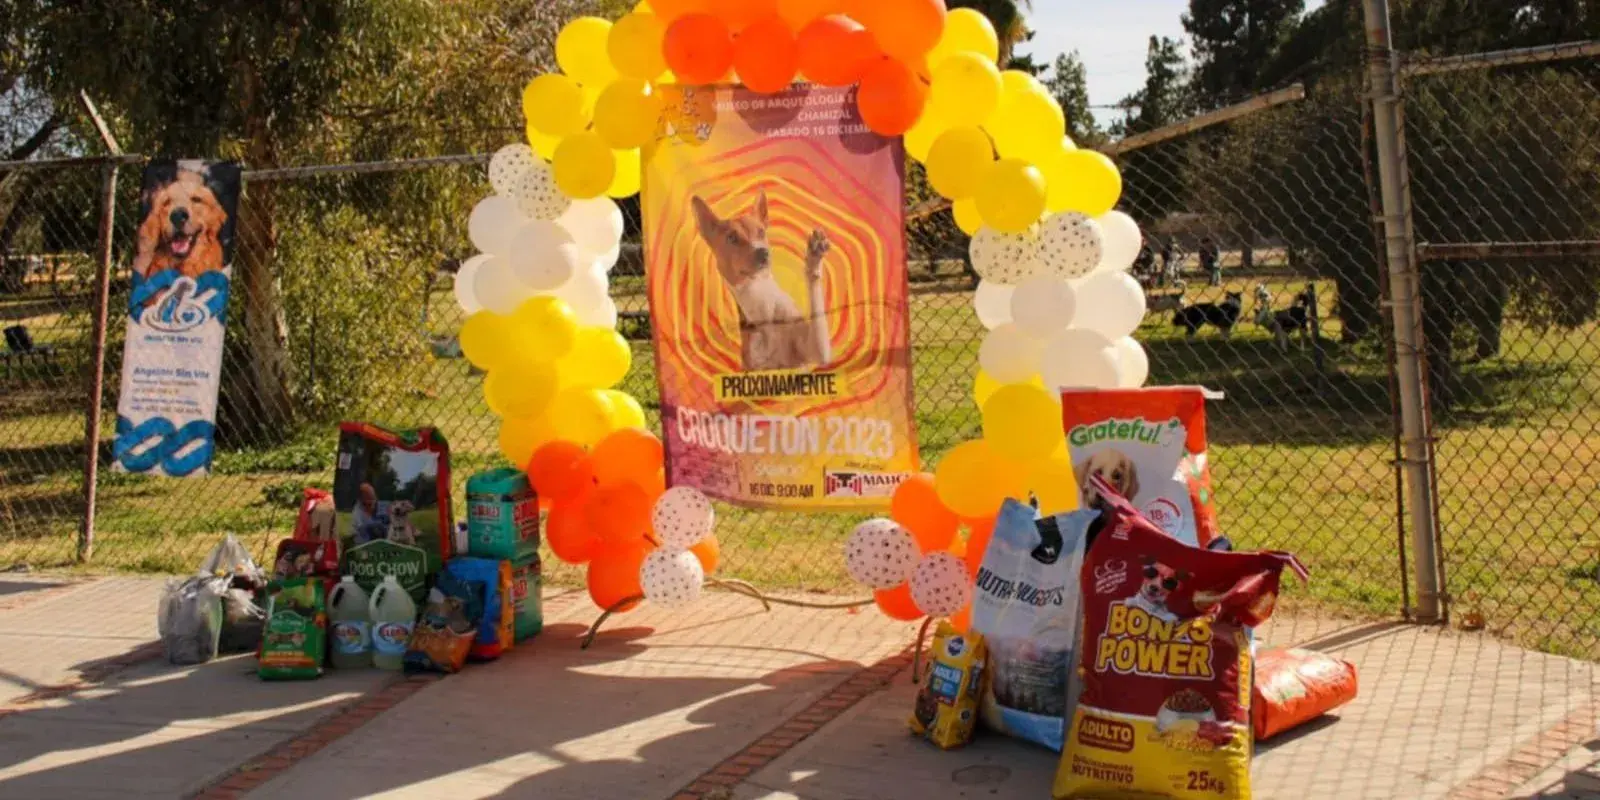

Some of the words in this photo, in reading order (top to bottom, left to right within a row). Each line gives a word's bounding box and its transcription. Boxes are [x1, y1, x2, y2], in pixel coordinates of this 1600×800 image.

[751, 100, 765, 110] DE
[797, 110, 852, 121] CHAMIZAL
[813, 126, 825, 136] 16
[676, 405, 821, 454] CROQUETON
[826, 416, 894, 460] 2023
[1069, 418, 1162, 447] Grateful
[799, 484, 814, 498] AM
[349, 560, 375, 577] DOG
[376, 560, 420, 577] CHOW
[1099, 637, 1211, 677] POWER
[1080, 719, 1132, 742] ADULTO
[1071, 762, 1134, 784] NUTRITIVO
